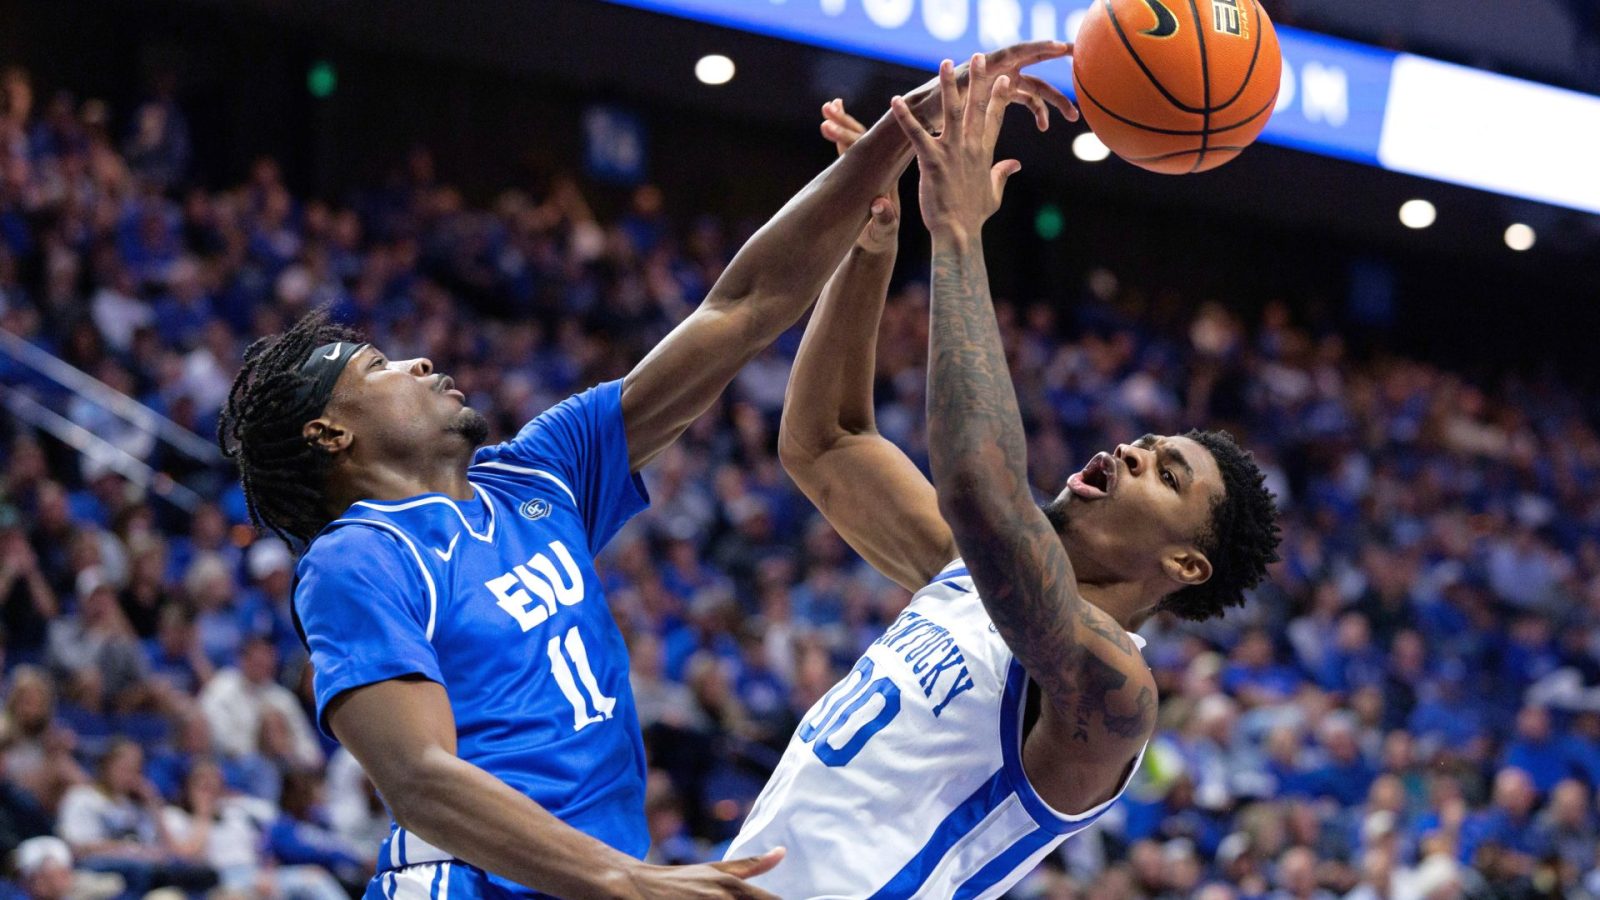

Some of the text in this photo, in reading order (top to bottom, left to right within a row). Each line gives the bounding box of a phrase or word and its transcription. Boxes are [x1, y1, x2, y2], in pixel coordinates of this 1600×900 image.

[484, 540, 584, 633] EIU
[547, 625, 617, 732] 11
[799, 655, 901, 768] 00
[875, 611, 975, 718] ENTUCKY
